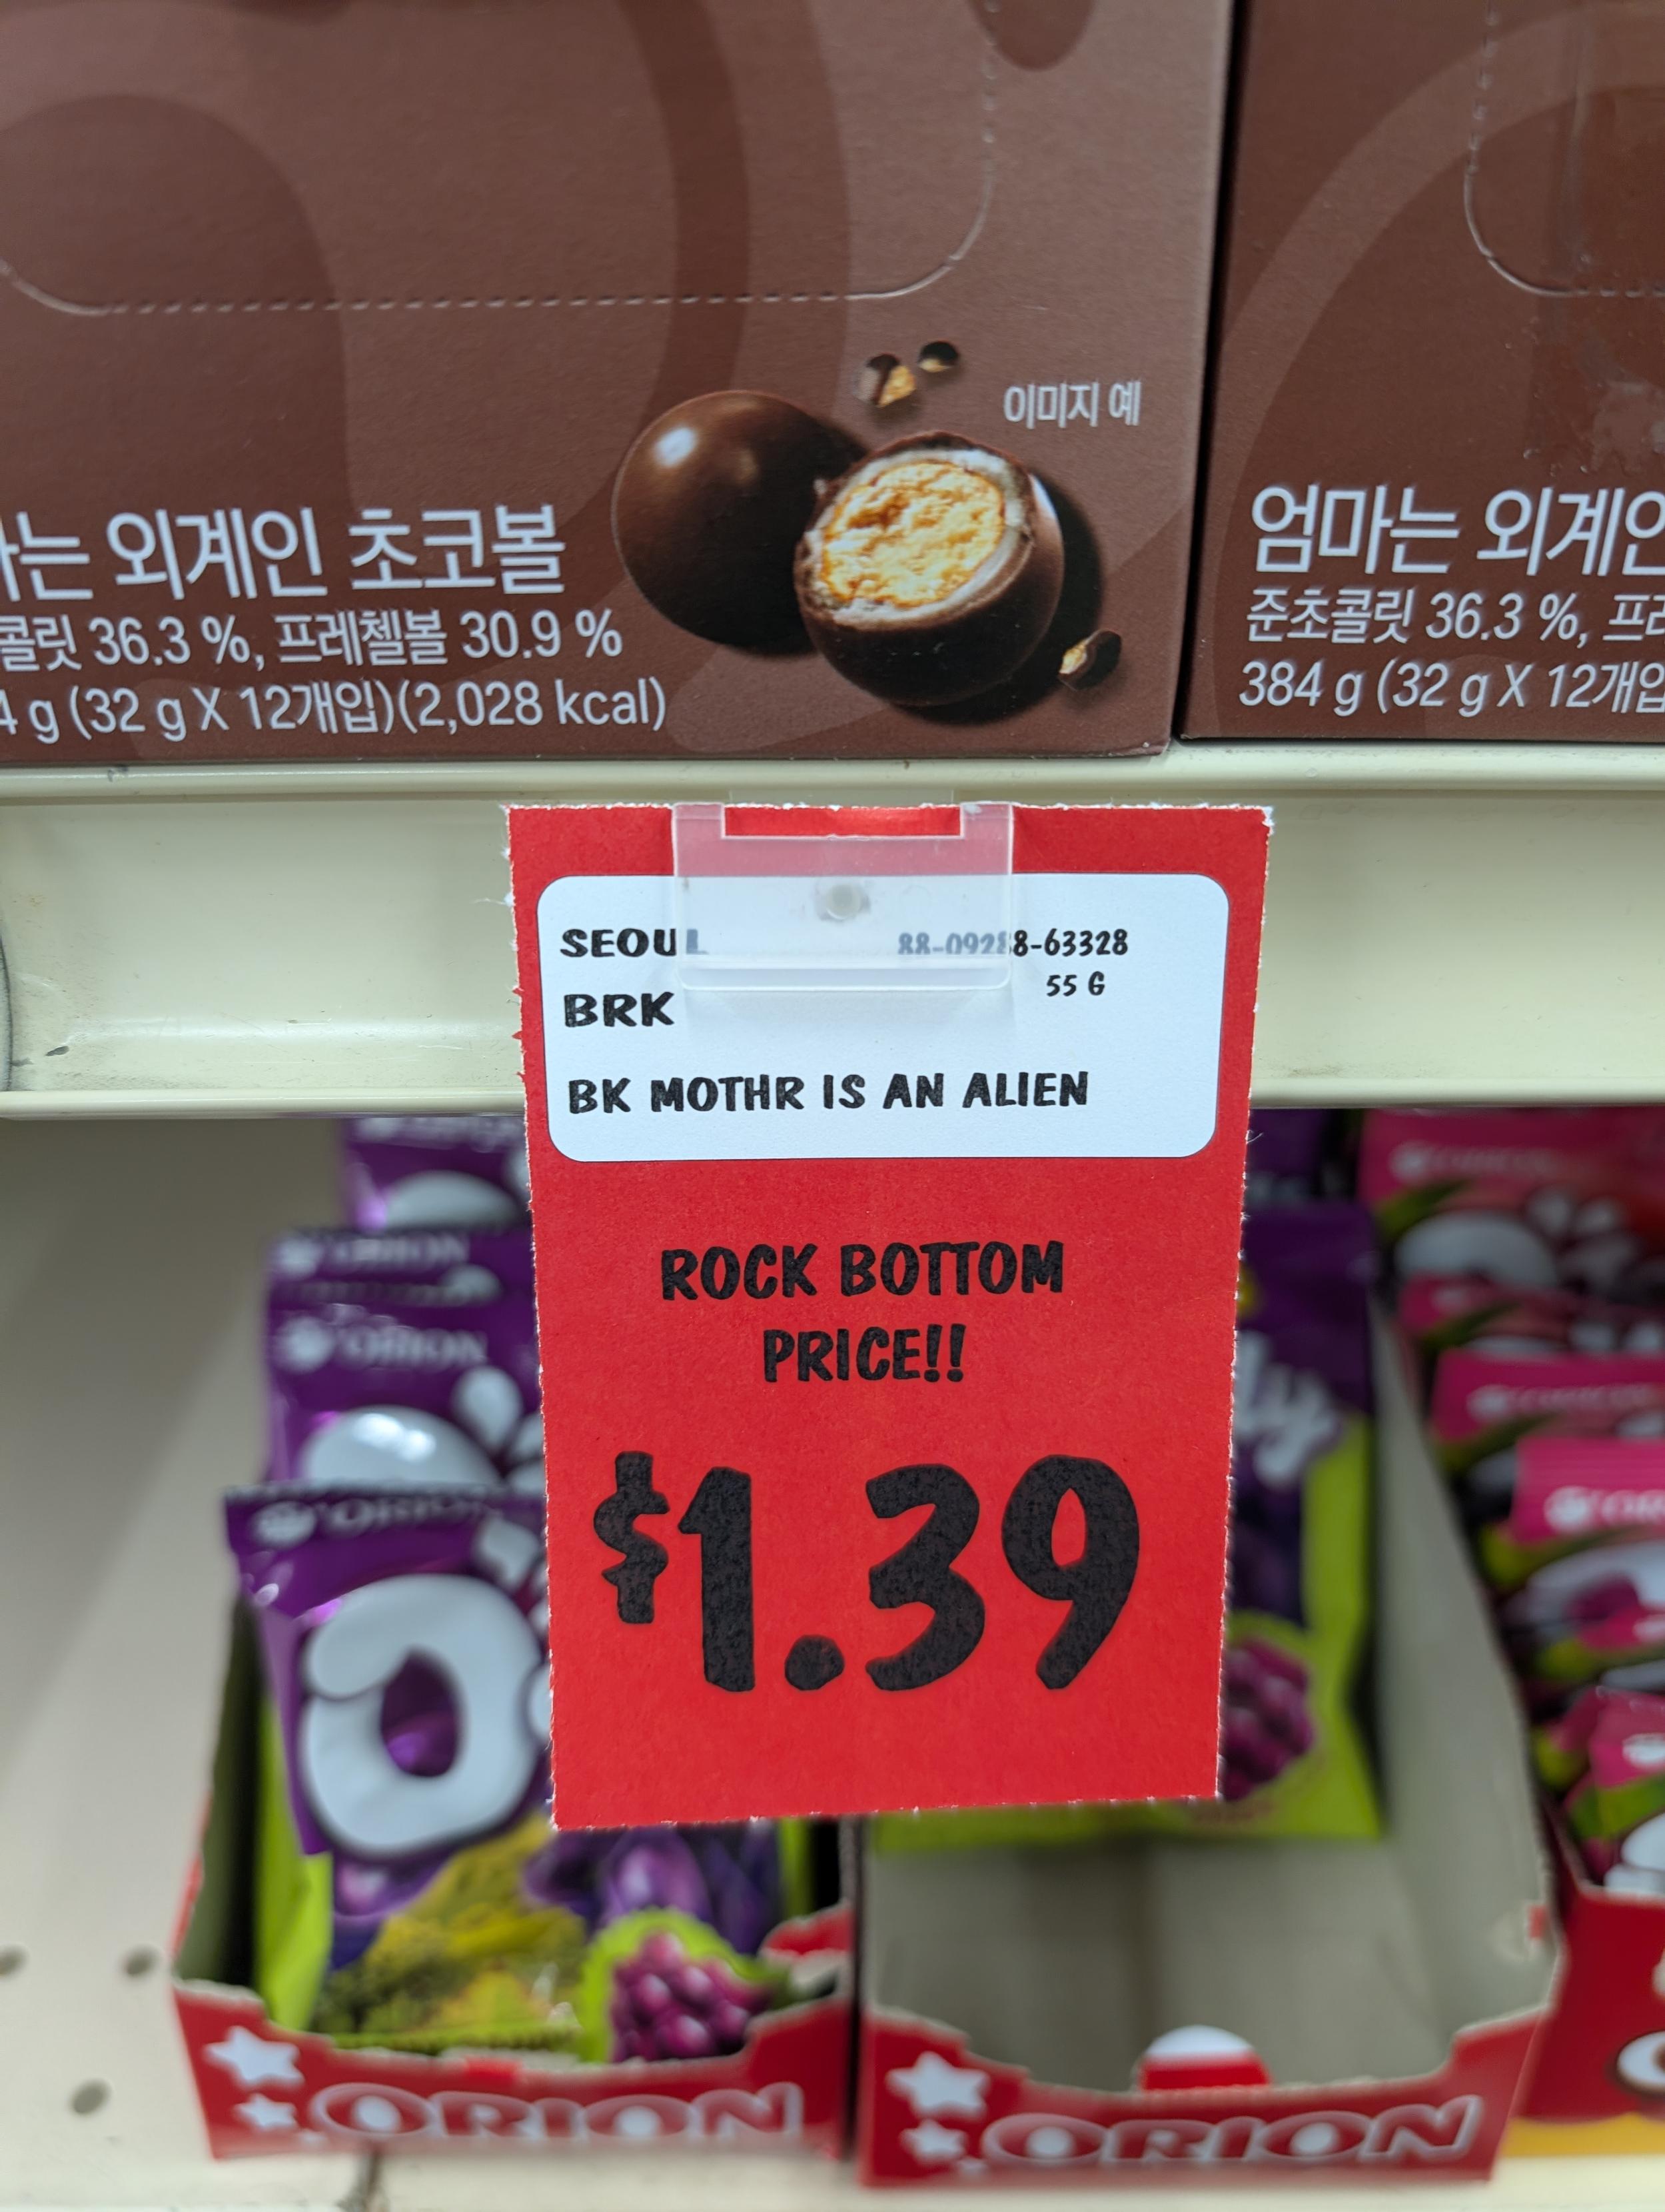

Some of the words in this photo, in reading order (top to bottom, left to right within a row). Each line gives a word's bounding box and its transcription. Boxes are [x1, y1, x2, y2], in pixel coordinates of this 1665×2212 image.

[1003, 381, 1100, 429] 이미지
[1108, 380, 1142, 427] 예
[107, 507, 328, 600] 외계인
[348, 505, 565, 594] 초코볼
[1251, 484, 1460, 574] 엄마는
[89, 616, 191, 665] 36.3
[201, 615, 265, 671] %,
[275, 610, 448, 666] 프레첼볼
[460, 610, 561, 658] 30.9
[576, 608, 622, 658] %
[1247, 588, 1414, 644] 준초콜릿
[1425, 592, 1524, 640] 36.3
[1539, 592, 1587, 648] %,
[29, 700, 59, 744] g
[70, 685, 145, 740] (32
[157, 698, 187, 742] g
[555, 676, 666, 731] kcal)
[1239, 660, 1323, 706] 384
[1334, 672, 1363, 716] g
[1377, 658, 1449, 714] (32
[1458, 673, 1489, 718] g
[560, 928, 709, 958] SEOUL
[564, 991, 675, 1028] BRK
[1047, 974, 1077, 997] 55
[1088, 971, 1105, 996] G
[568, 1078, 631, 1114] BK
[650, 1074, 804, 1112] MOTHR
[824, 1074, 866, 1110] IS
[883, 1072, 945, 1110] AN
[962, 1070, 1089, 1109] ALIEN
[661, 1243, 818, 1301] ROCK
[840, 1240, 1065, 1297] BOTTOM
[764, 1323, 967, 1383] PRICE!!
[592, 1451, 1141, 1693] $1.39
[310, 2082, 804, 2143] ORION
[983, 2094, 1483, 2165] ORION
